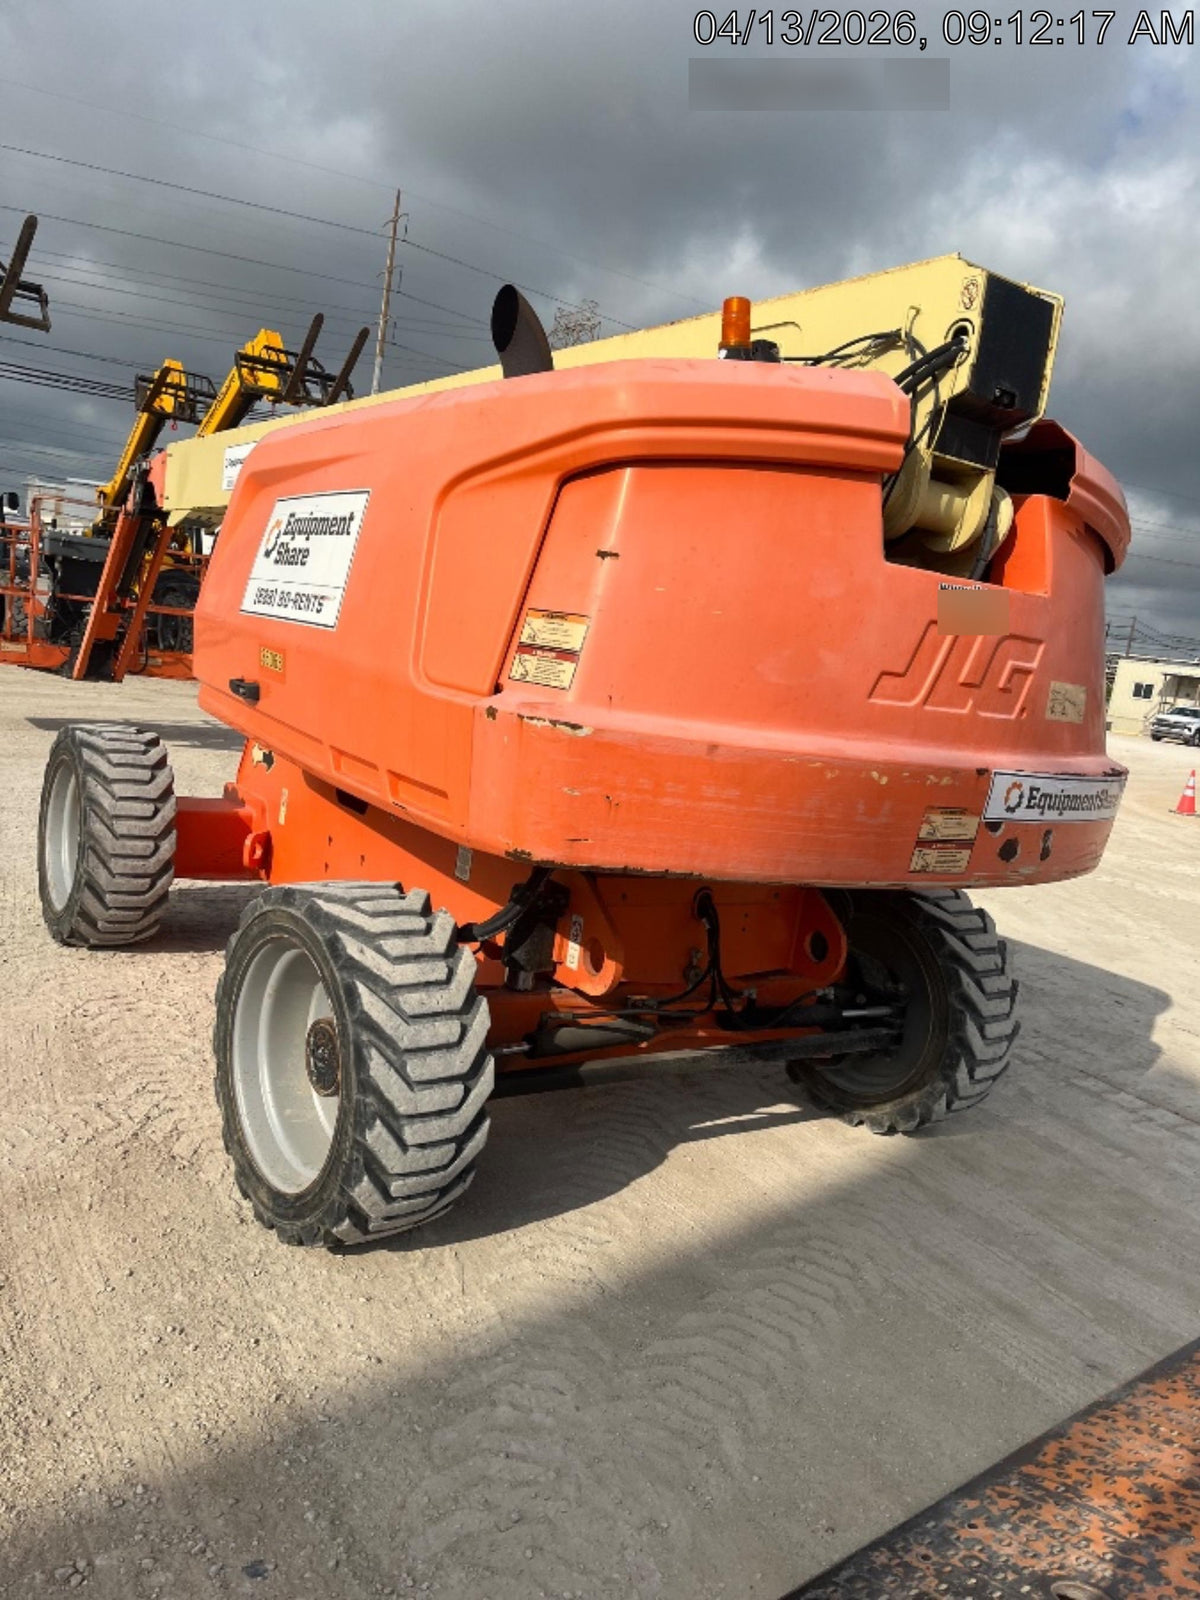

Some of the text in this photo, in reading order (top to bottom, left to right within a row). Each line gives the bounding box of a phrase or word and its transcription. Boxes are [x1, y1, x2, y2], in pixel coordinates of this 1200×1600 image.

[282, 511, 355, 541] Equipment
[273, 541, 310, 566] Share
[868, 618, 1046, 720] JLG
[1024, 786, 1119, 817] EquipmentSh
